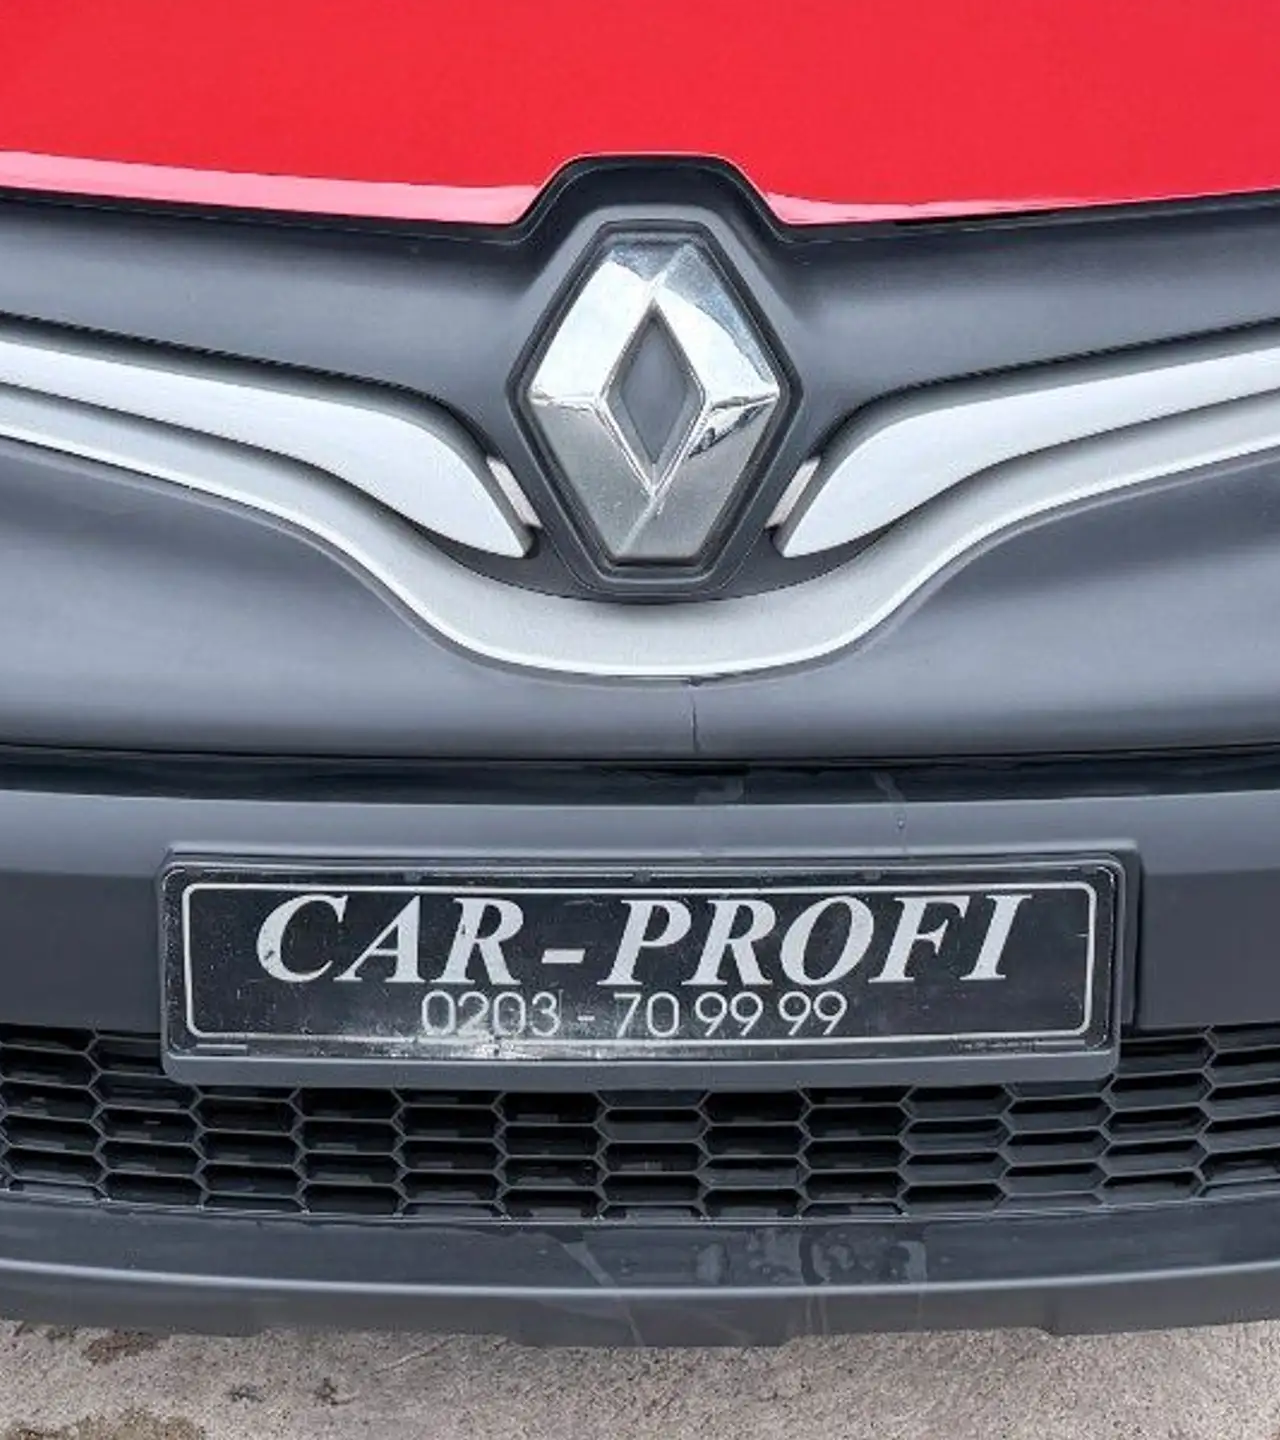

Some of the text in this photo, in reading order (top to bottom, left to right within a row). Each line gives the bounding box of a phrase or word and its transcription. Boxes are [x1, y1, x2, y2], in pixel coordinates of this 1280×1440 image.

[420, 990, 562, 1038] 0203
[613, 991, 681, 1039] 70
[694, 990, 764, 1037] 99
[777, 990, 849, 1037] 99
